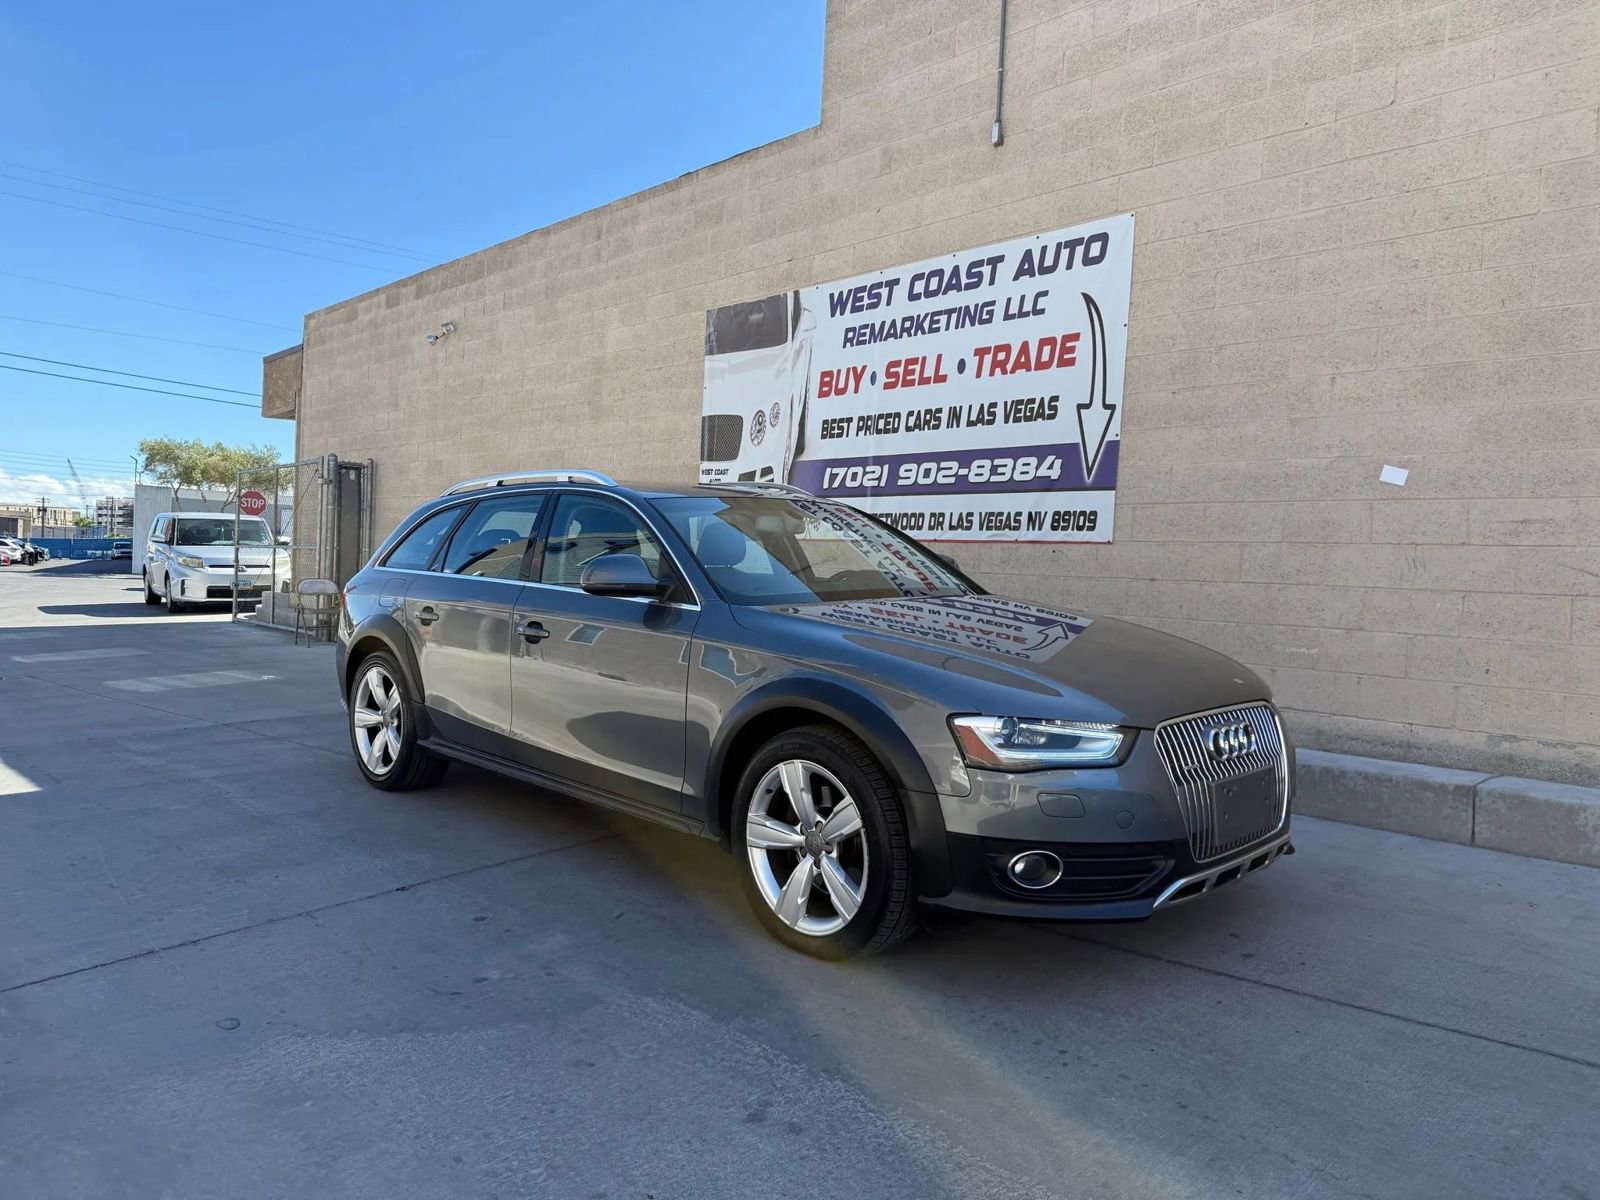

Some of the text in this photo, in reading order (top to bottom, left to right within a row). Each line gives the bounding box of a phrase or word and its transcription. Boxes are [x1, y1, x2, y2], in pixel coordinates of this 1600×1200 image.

[828, 231, 1110, 318] WEST COAST AUTO
[842, 290, 1049, 349] REMARKETING LLC
[817, 332, 1081, 398] BUY SELL TRADE
[820, 395, 1060, 440] BEST PRICED CARS IN LAS VEGAS
[822, 455, 1063, 489] (702) 902-8384
[240, 497, 265, 509] STOP
[928, 512, 944, 532] DR
[948, 511, 975, 531] LAS
[978, 511, 1024, 532] VEGAS
[1026, 511, 1048, 532] NV
[1050, 510, 1098, 532] 89109
